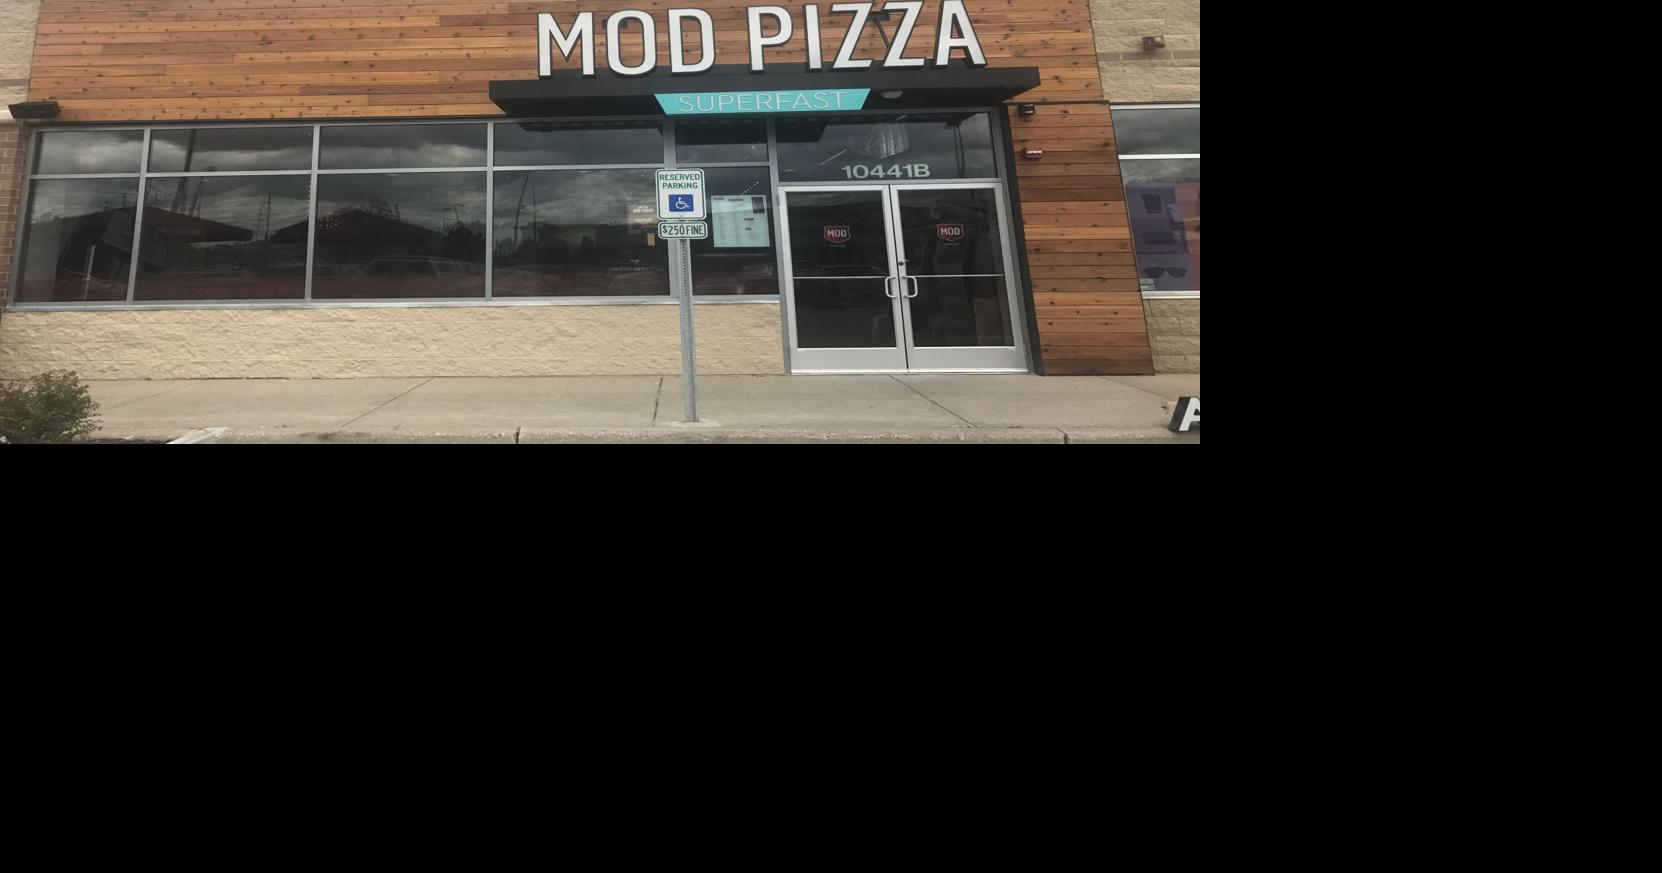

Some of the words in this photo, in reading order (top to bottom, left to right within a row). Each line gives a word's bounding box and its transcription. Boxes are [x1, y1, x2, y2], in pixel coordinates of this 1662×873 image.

[538, 9, 716, 76] MOD
[748, 0, 988, 72] PIZZA
[678, 90, 848, 112] SUPERFAST
[841, 163, 931, 179] 10441B
[660, 173, 700, 181] RESERVED
[662, 225, 684, 235] $250
[686, 225, 704, 235] FINE
[827, 229, 847, 238] MOD
[940, 227, 960, 236] MOD
